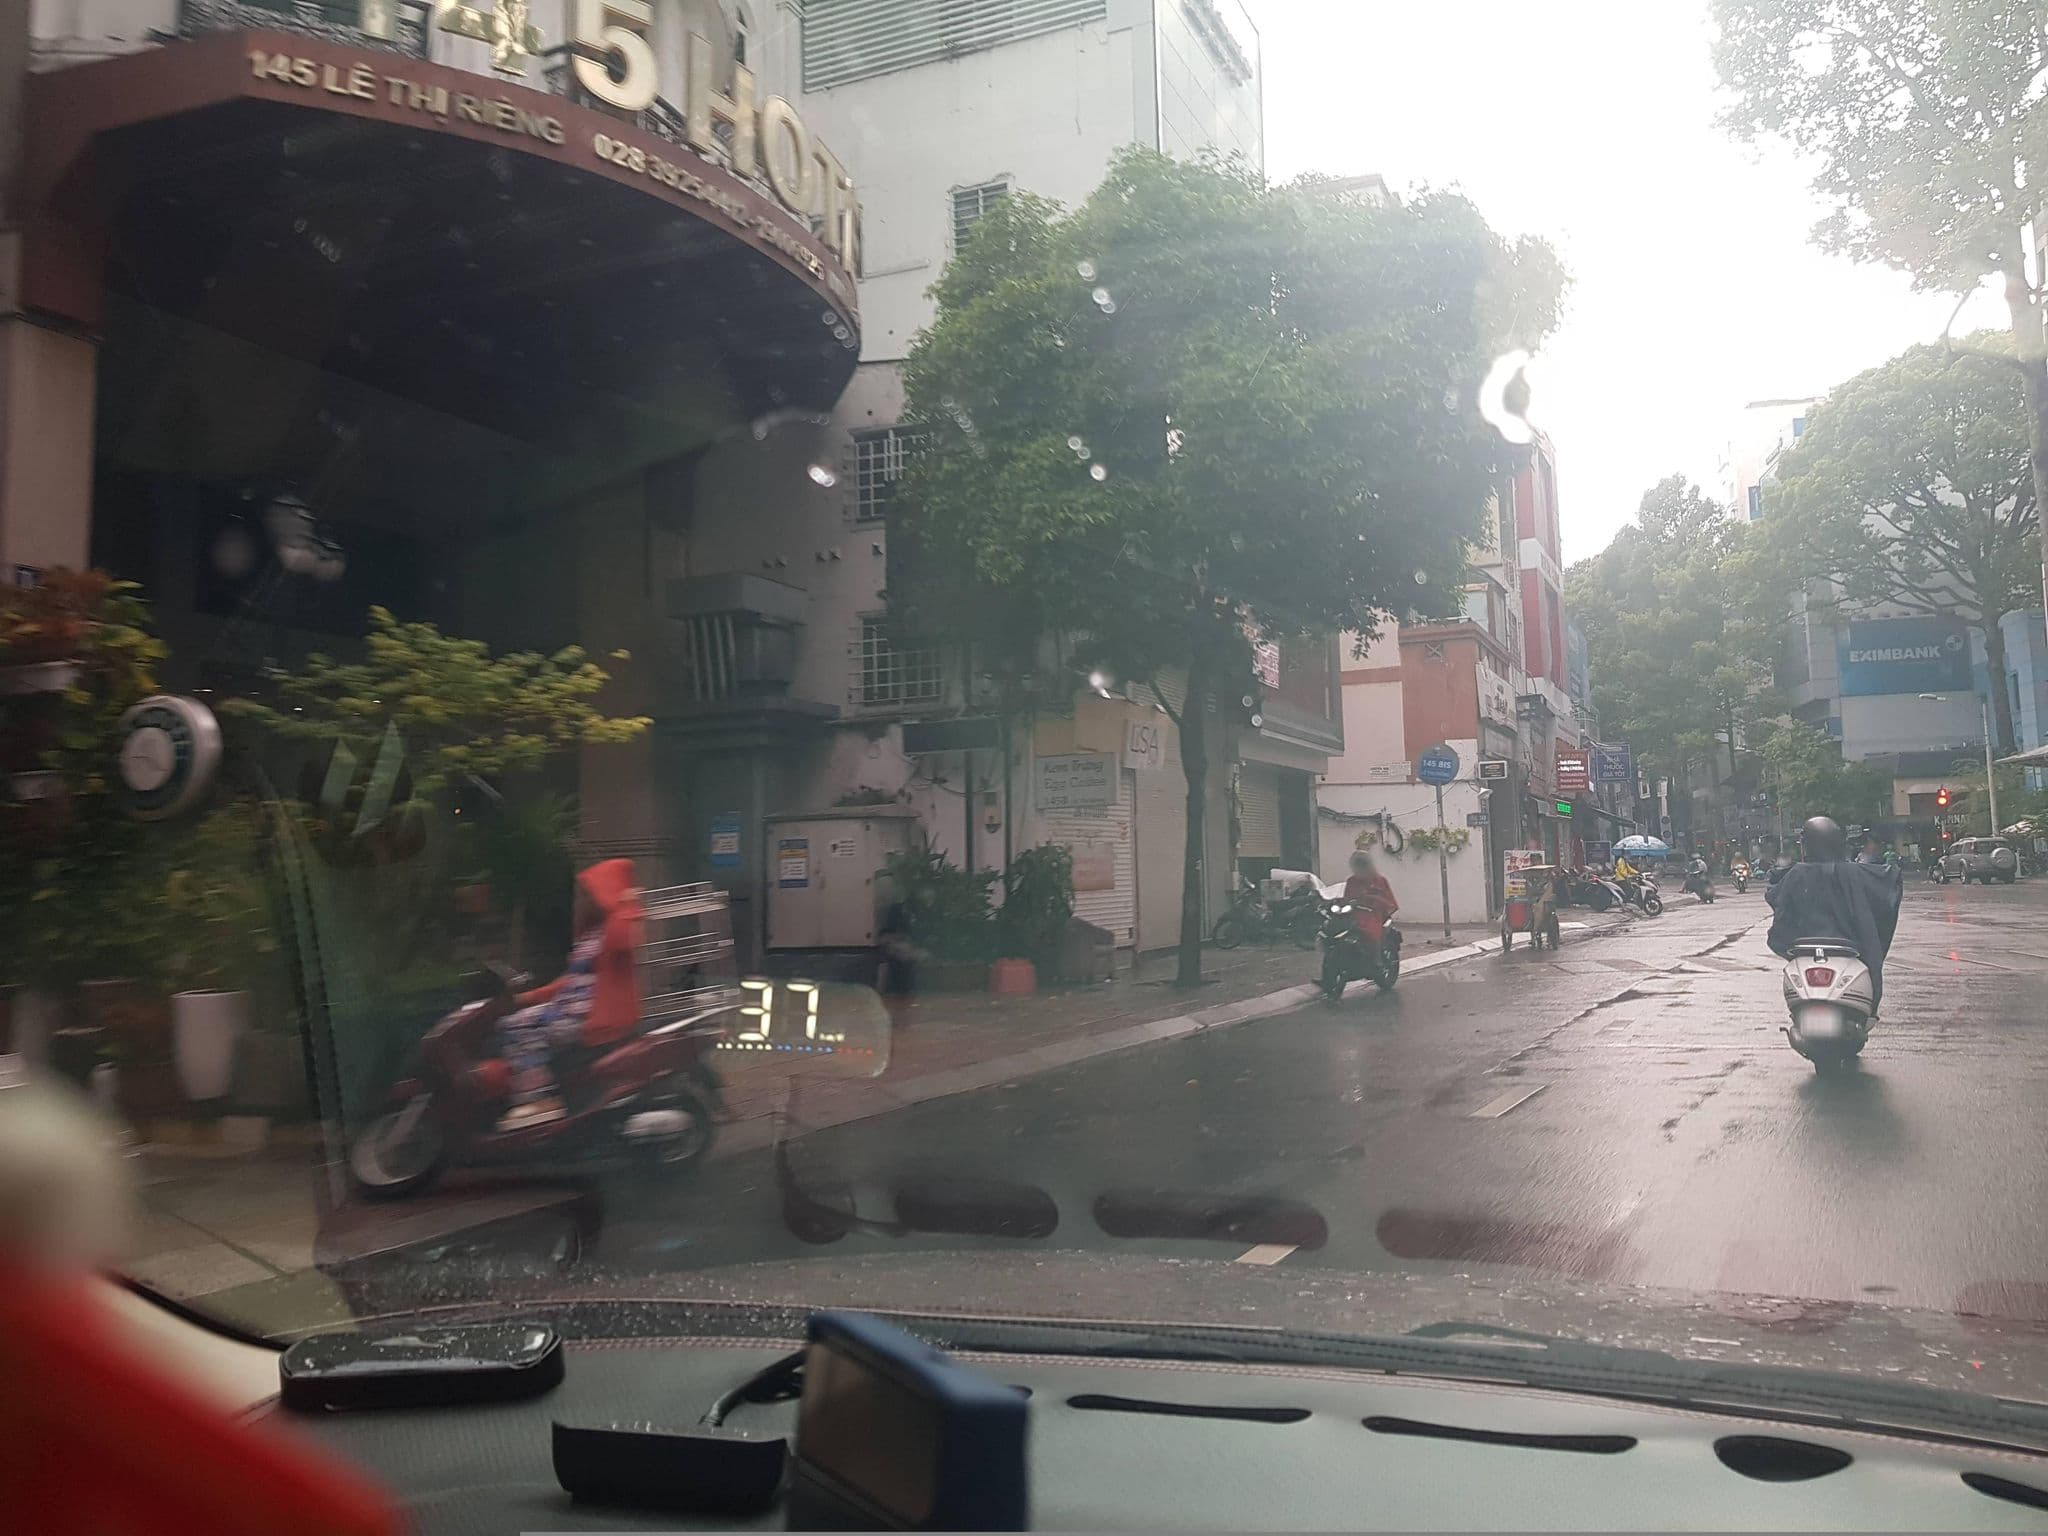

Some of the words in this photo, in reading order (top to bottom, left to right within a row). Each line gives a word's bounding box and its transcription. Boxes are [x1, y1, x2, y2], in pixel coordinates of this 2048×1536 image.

[248, 49, 318, 89] 145
[321, 62, 377, 101] LÊ
[384, 75, 449, 124] THỊ
[453, 92, 567, 145] RIÊNG
[1849, 645, 1941, 662] EXIMBANK
[738, 981, 818, 1041] 37
